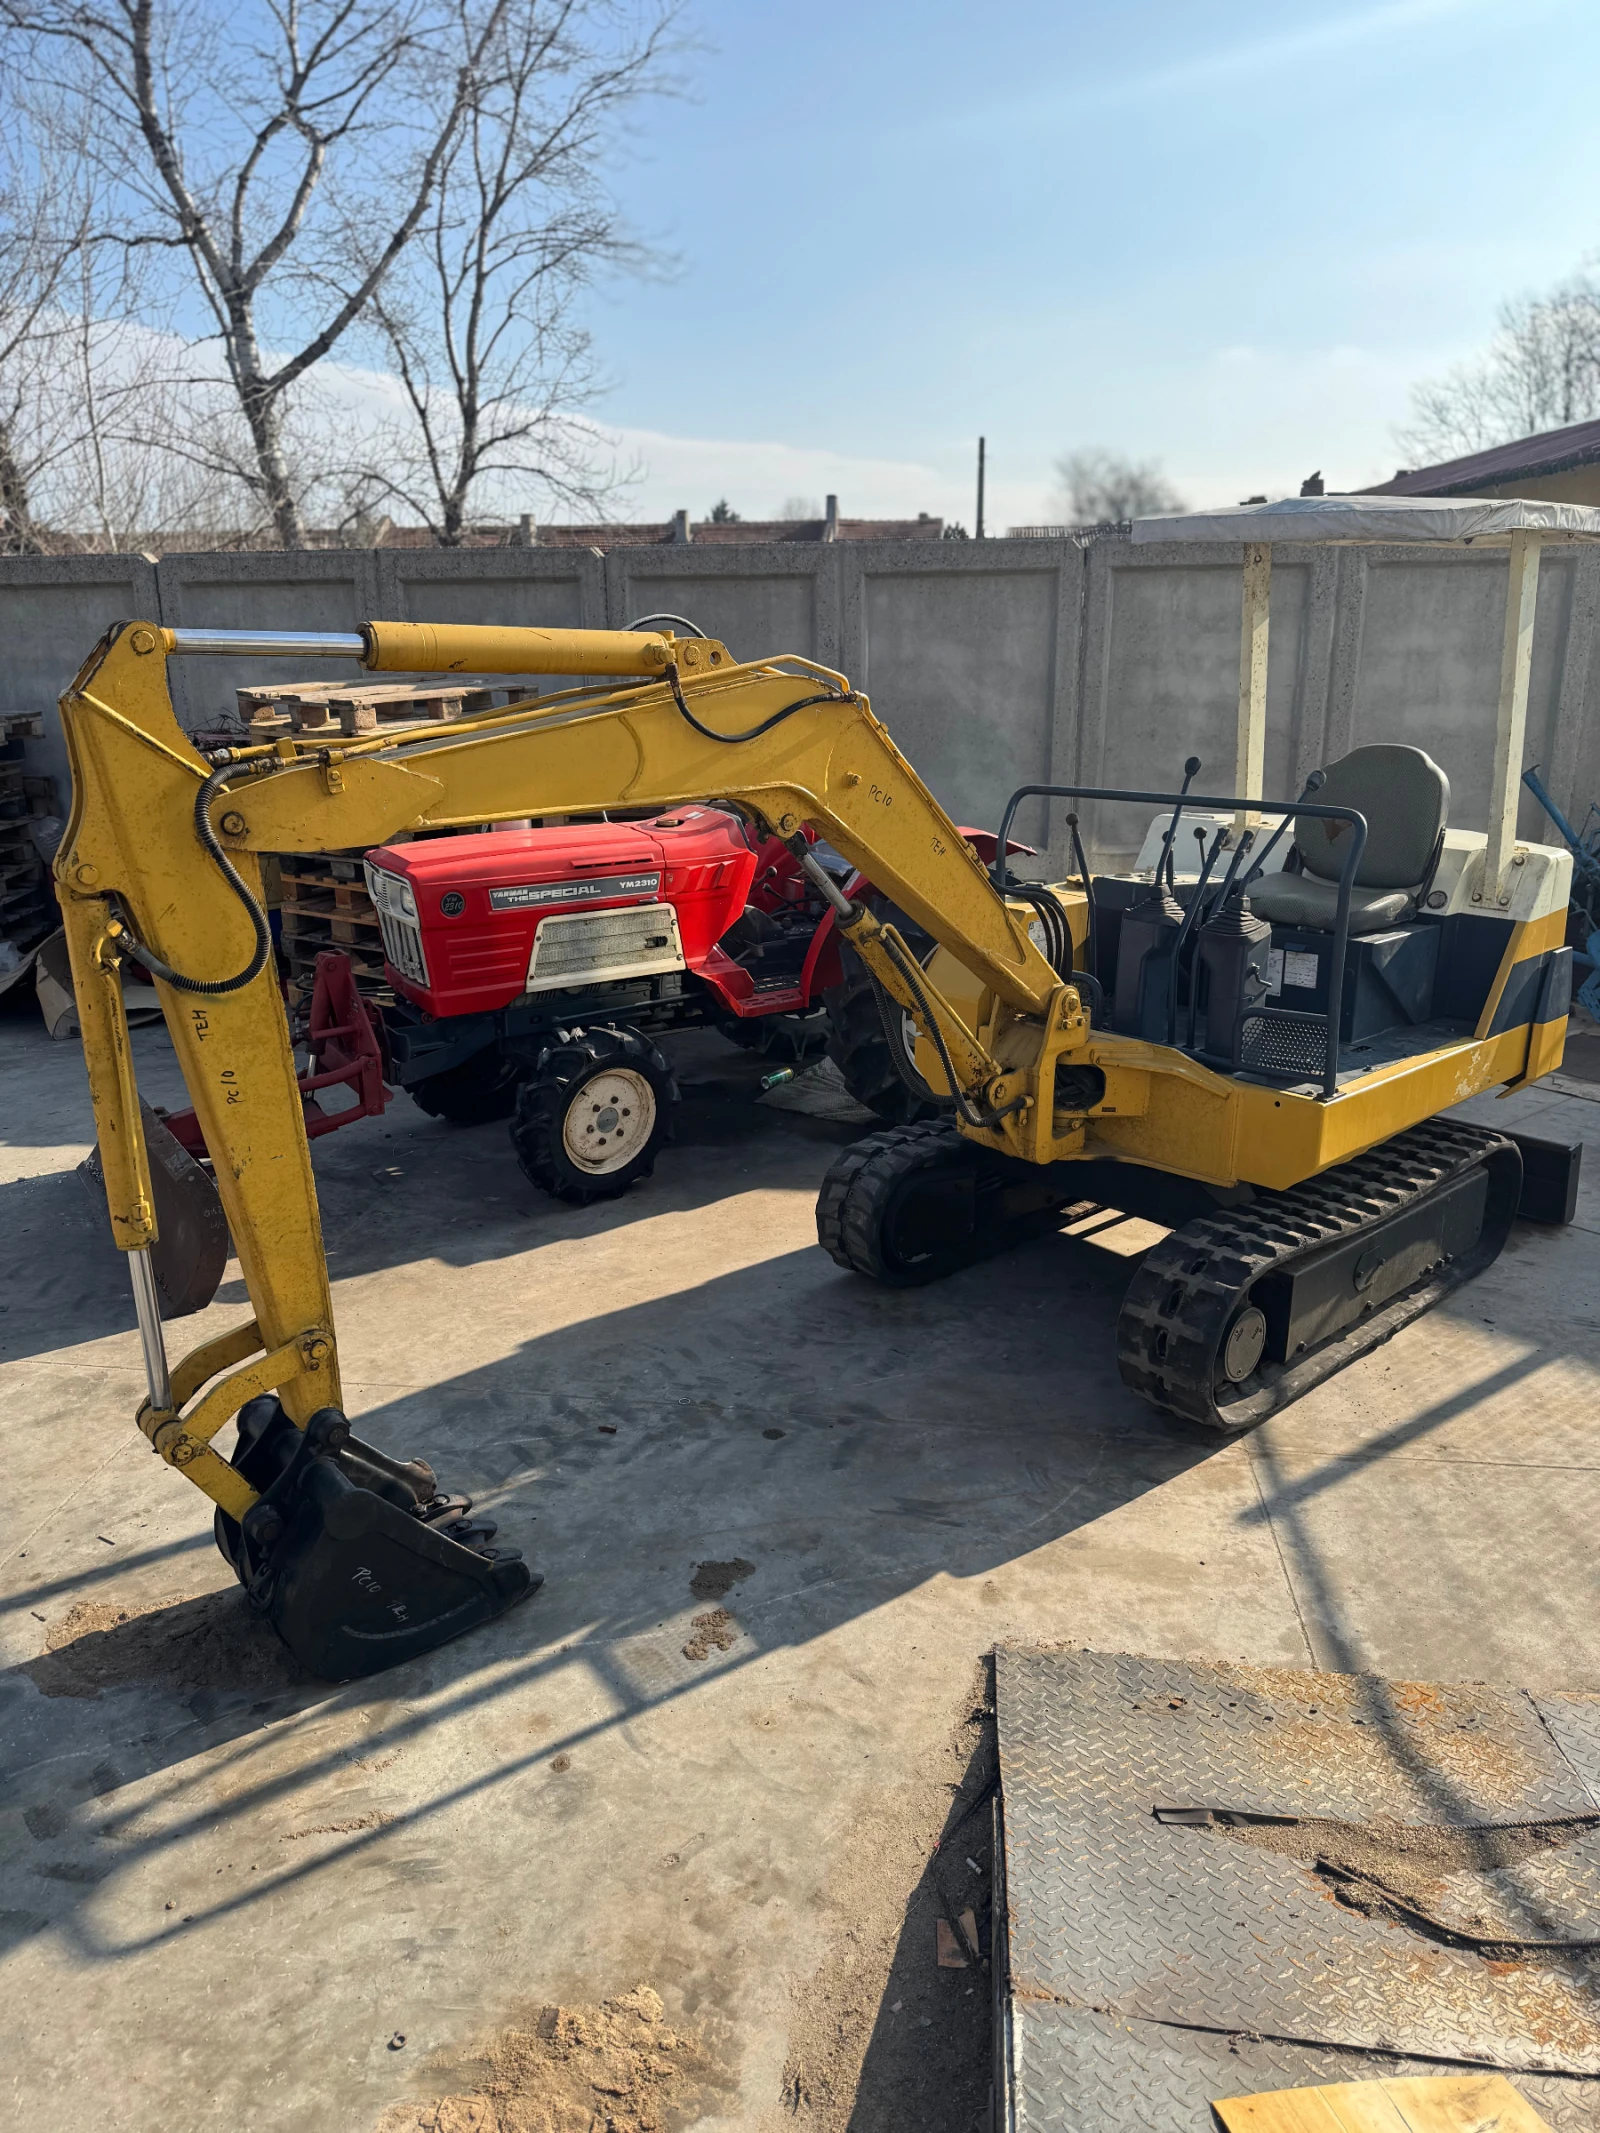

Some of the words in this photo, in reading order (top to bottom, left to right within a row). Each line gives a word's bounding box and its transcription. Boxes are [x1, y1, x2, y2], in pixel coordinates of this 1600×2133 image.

[868, 784, 893, 807] PC10
[930, 836, 947, 858] TEH
[619, 878, 658, 889] YM2310
[507, 894, 529, 903] THE
[528, 885, 601, 900] SPECIAL
[444, 901, 464, 911] 2310
[351, 1566, 382, 1593] PC10
